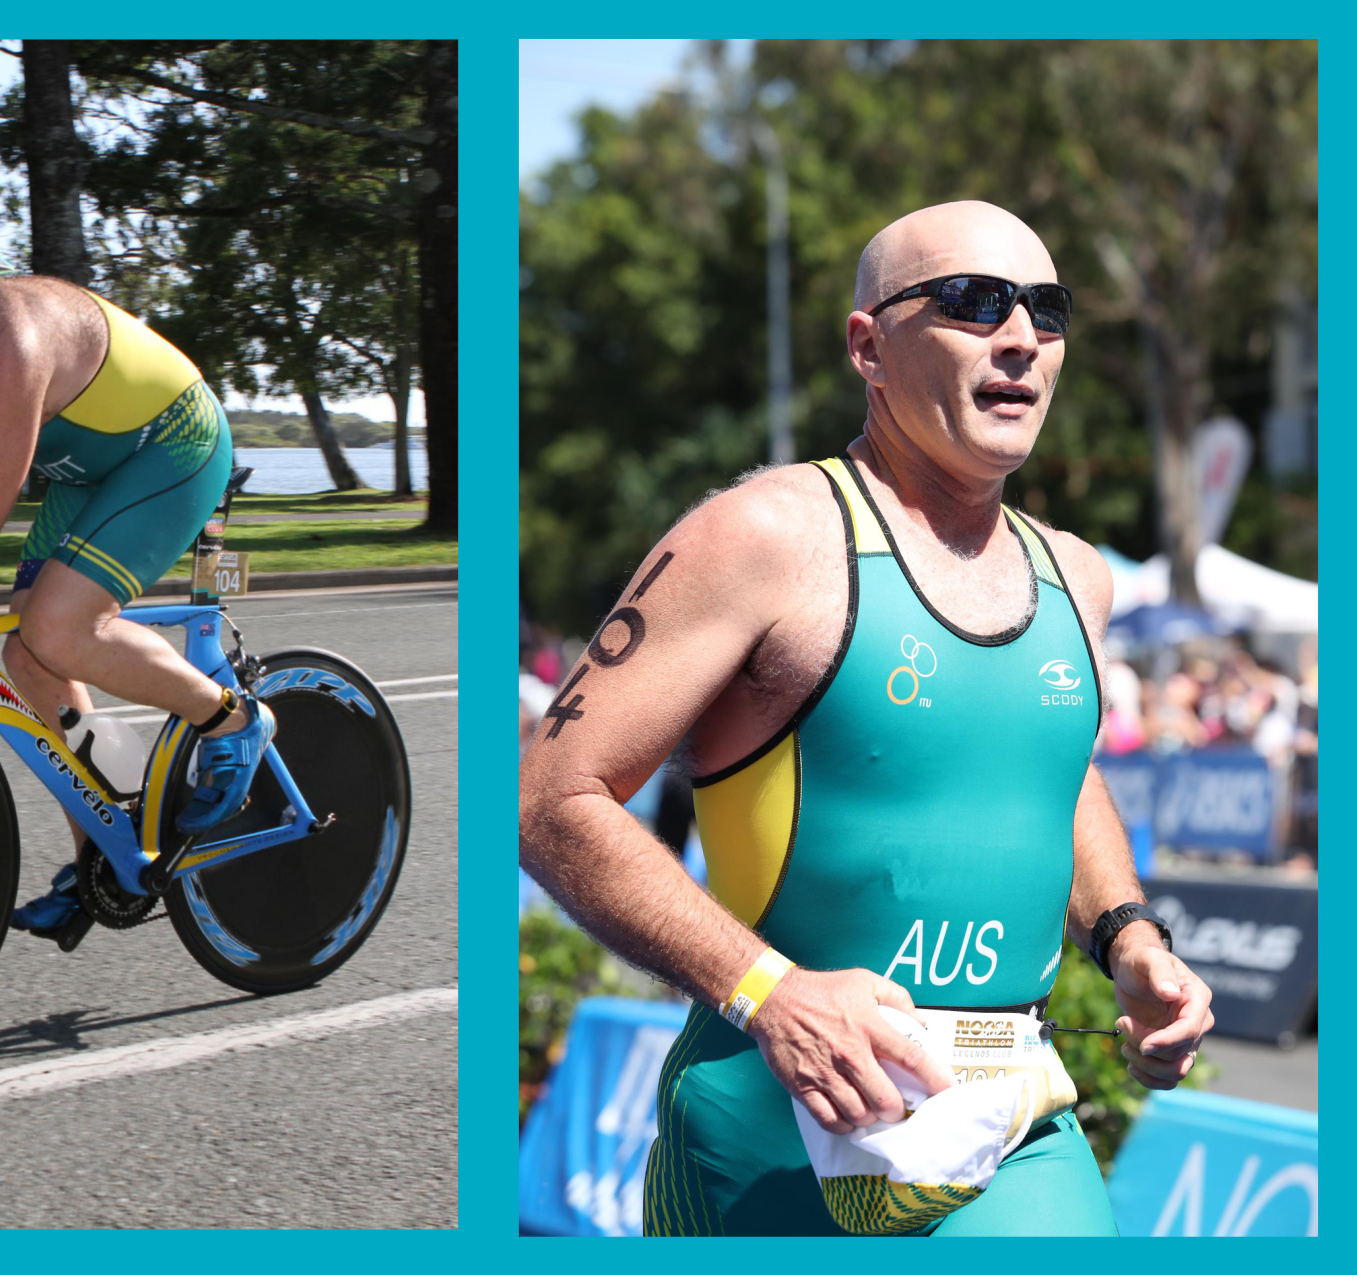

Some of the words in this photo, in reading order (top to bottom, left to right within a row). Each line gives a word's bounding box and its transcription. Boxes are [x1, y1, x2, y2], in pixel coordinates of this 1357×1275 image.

[215, 569, 241, 593] 104
[919, 697, 933, 709] ITU
[1041, 694, 1084, 706] SCODY
[883, 919, 1004, 986] AUS
[955, 1020, 1015, 1036] NOOSA
[956, 1038, 1013, 1047] TRIATHLON
[953, 1050, 990, 1058] LEGENDS
[992, 1050, 1013, 1058] CLUB
